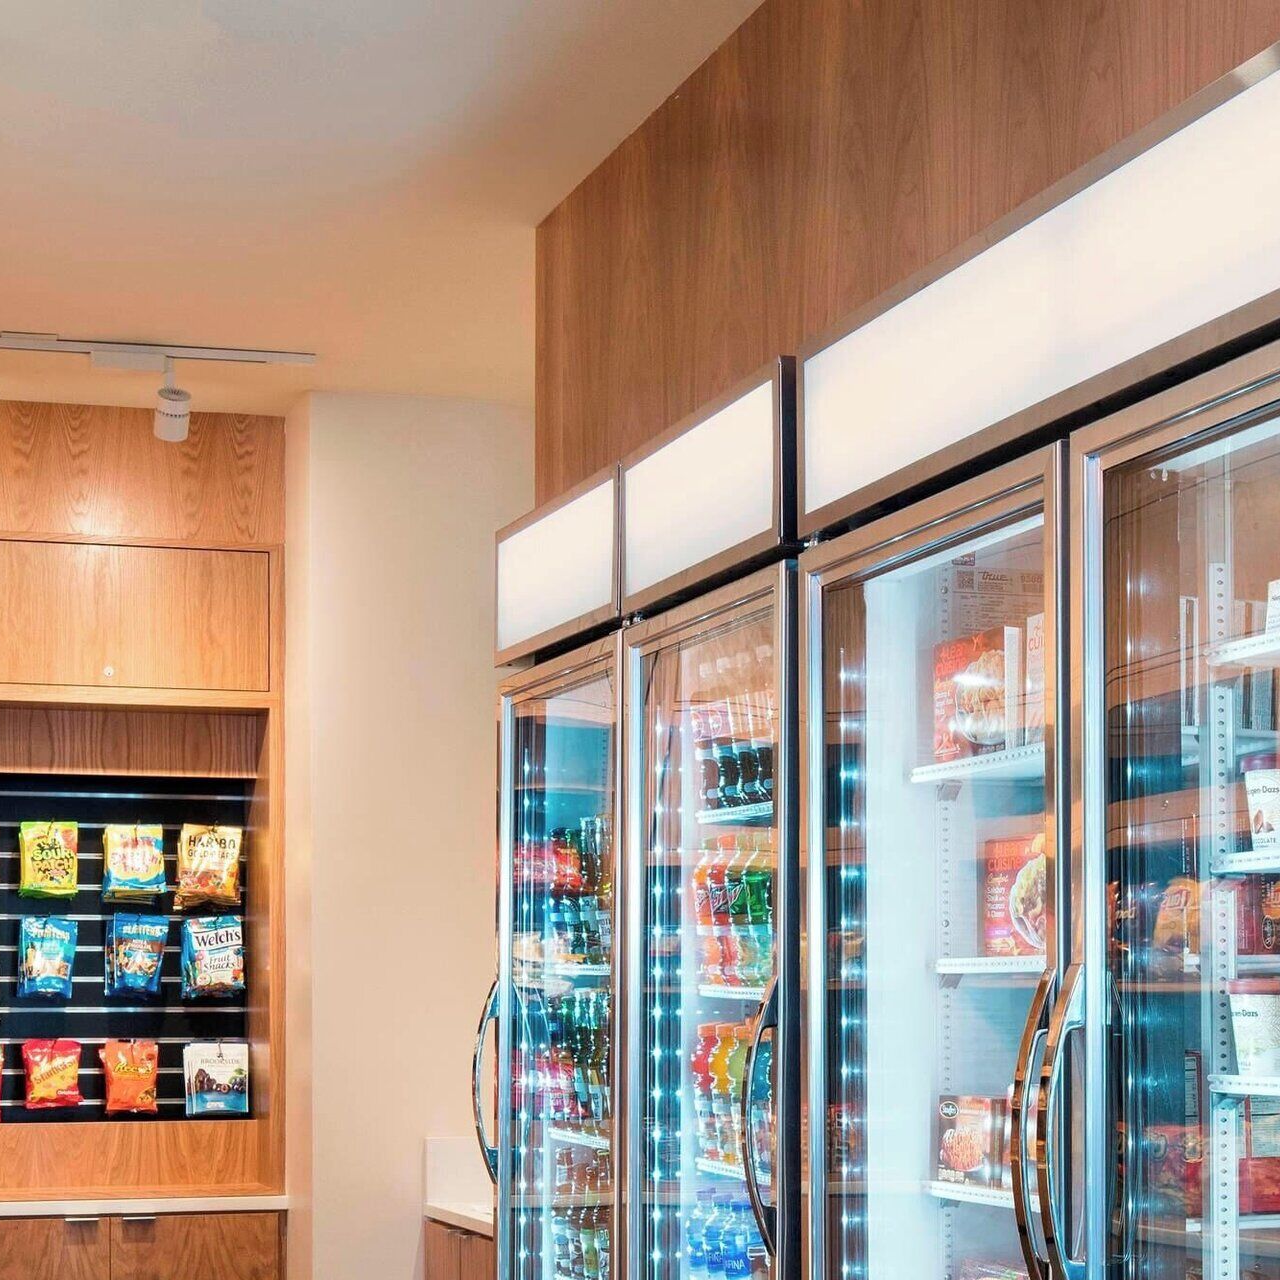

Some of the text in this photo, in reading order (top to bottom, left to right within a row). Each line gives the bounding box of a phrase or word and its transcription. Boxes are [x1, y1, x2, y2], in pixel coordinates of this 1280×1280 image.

[32, 847, 74, 861] SOUR
[32, 859, 74, 871] PATCH
[196, 929, 241, 947] Welch's
[210, 954, 231, 963] Fruit
[203, 960, 236, 971] Snacks
